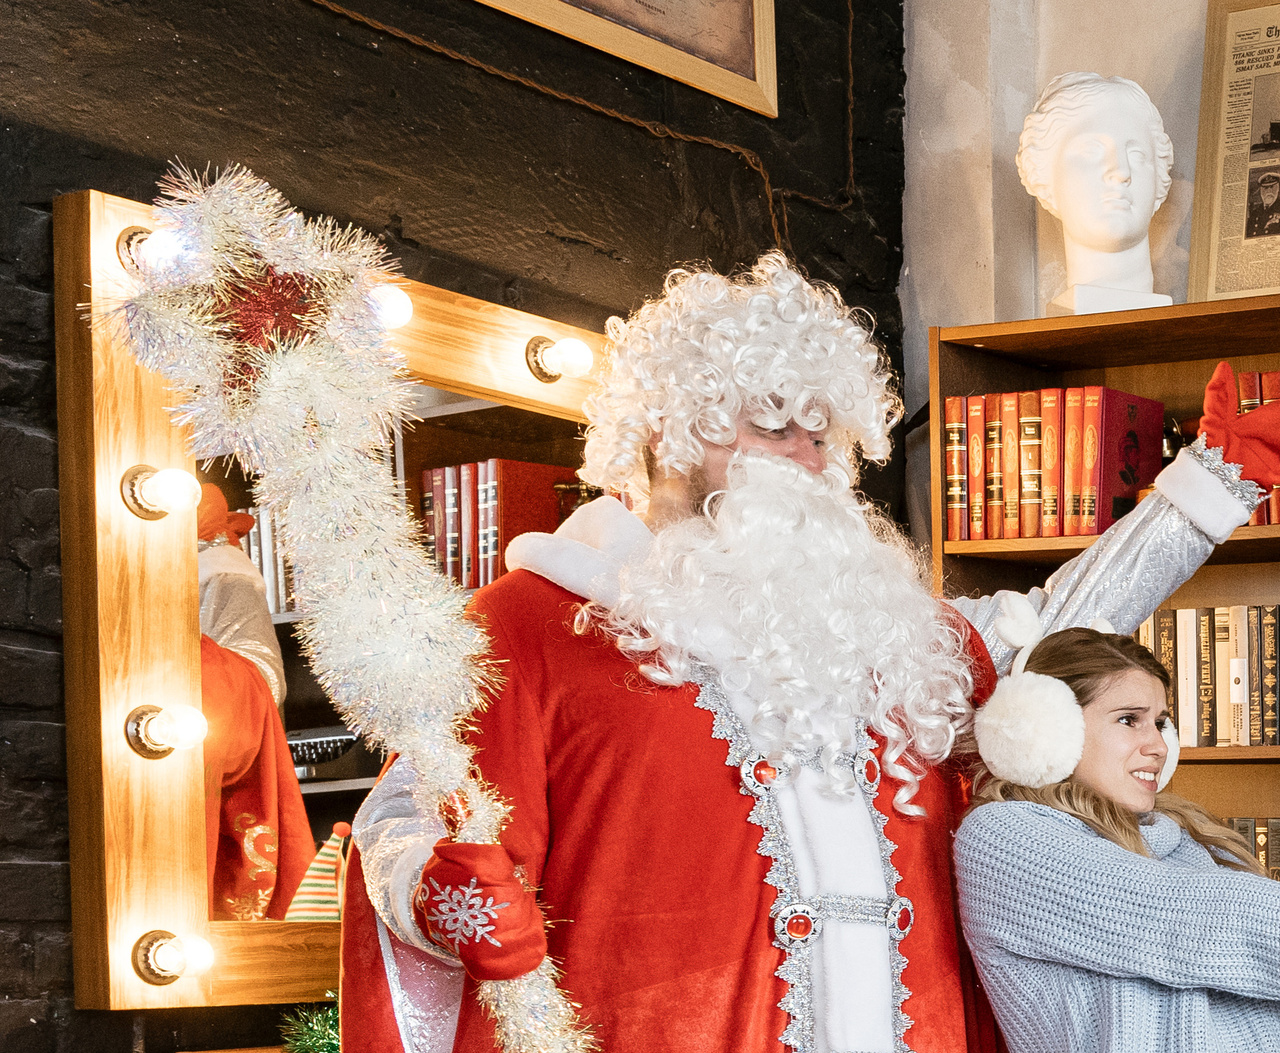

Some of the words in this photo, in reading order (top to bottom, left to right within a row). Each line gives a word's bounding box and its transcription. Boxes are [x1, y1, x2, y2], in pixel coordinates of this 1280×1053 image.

[1232, 51, 1256, 61] TITANIC
[1257, 47, 1276, 56] SINKS
[1246, 54, 1275, 64] RESCUED
[1235, 63, 1255, 73] ISMAY
